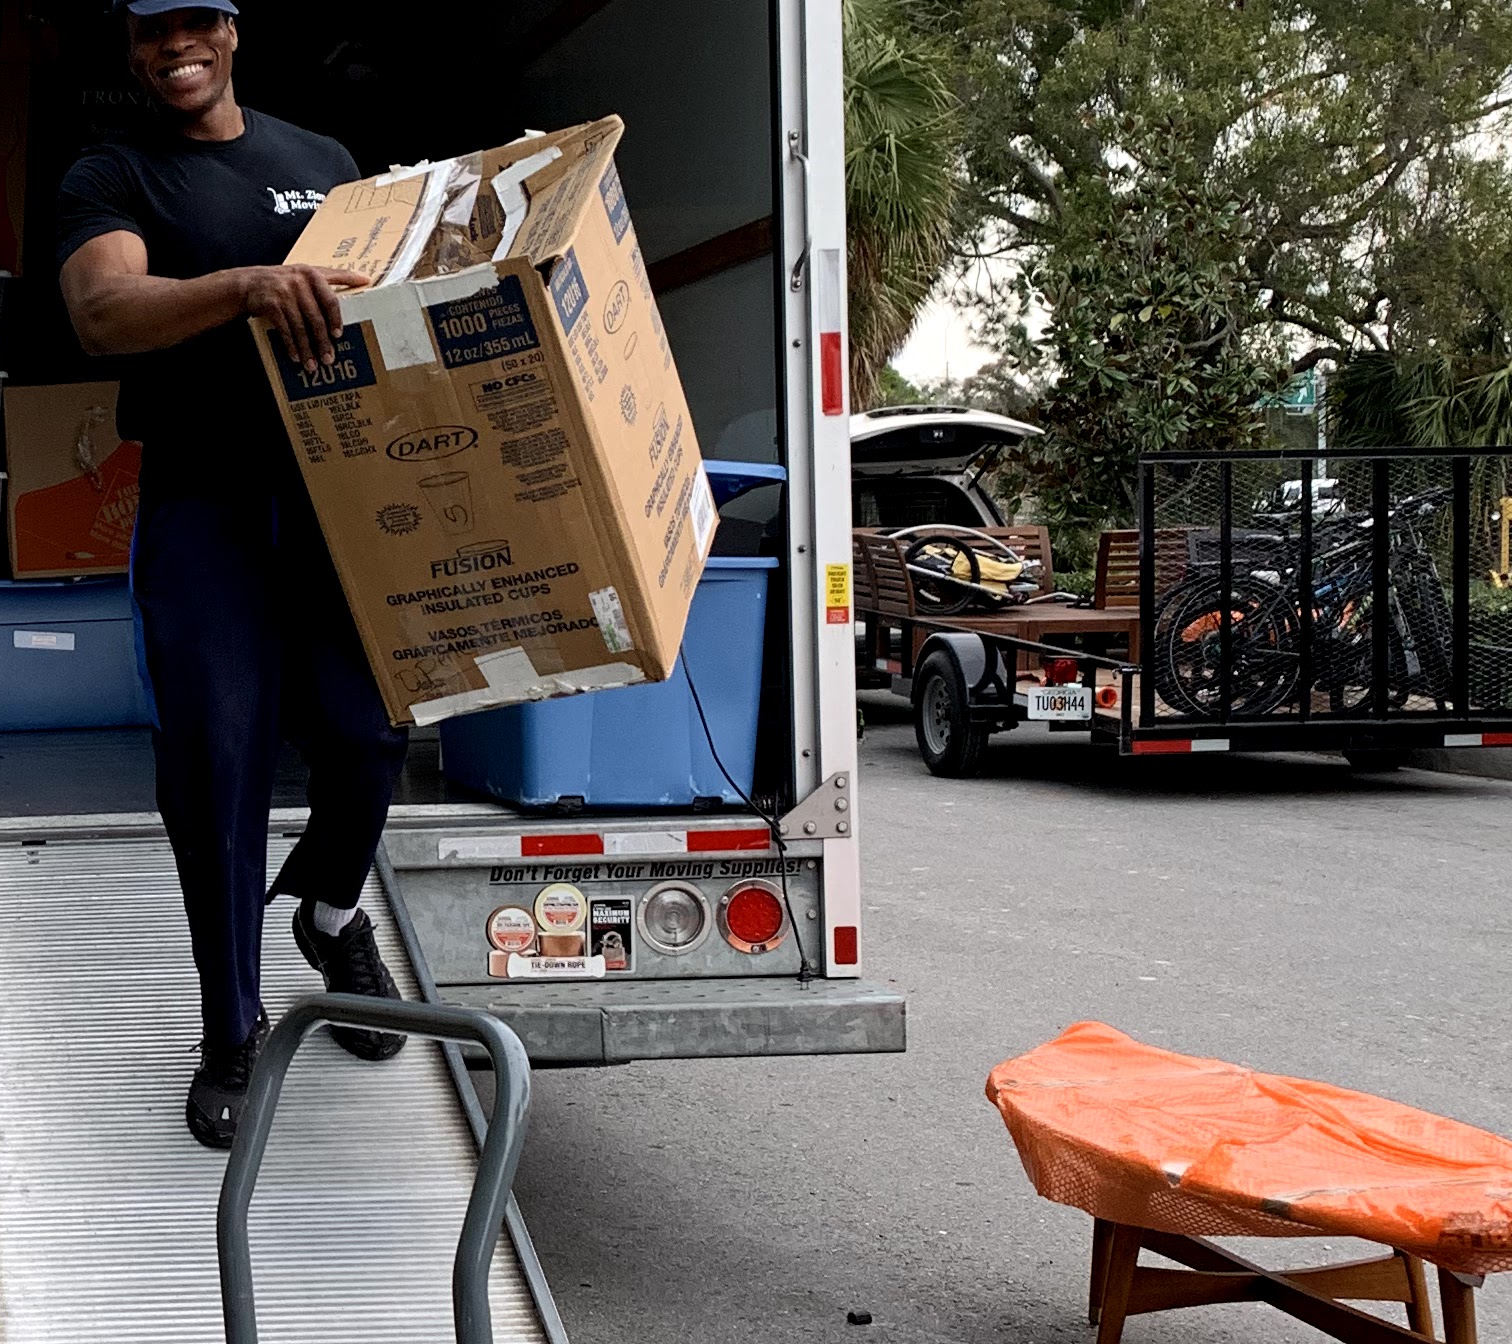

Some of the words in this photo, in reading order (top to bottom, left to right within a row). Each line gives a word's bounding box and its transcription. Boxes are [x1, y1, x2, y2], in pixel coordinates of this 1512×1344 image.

[284, 190, 304, 201] Mt.
[290, 199, 320, 210] Movi
[439, 312, 488, 340] 1000
[488, 303, 521, 319] PIECES
[491, 313, 524, 331] PIEZAS
[445, 348, 463, 365] 12
[512, 331, 535, 348] mL
[482, 379, 503, 394] NO
[397, 430, 465, 457] DART
[430, 550, 512, 580] FUSION
[386, 581, 488, 607] GRAPHICALLY
[491, 562, 580, 590] ENHANCED
[420, 592, 505, 616] INSULATED
[509, 583, 552, 601] CUPS
[428, 623, 480, 643] VASOS
[514, 616, 600, 641] MEJORADO
[490, 865, 538, 882] Don't
[543, 863, 600, 884] Forget
[605, 862, 645, 880] Your
[649, 860, 715, 880] Moving
[719, 858, 802, 878] Supplies!
